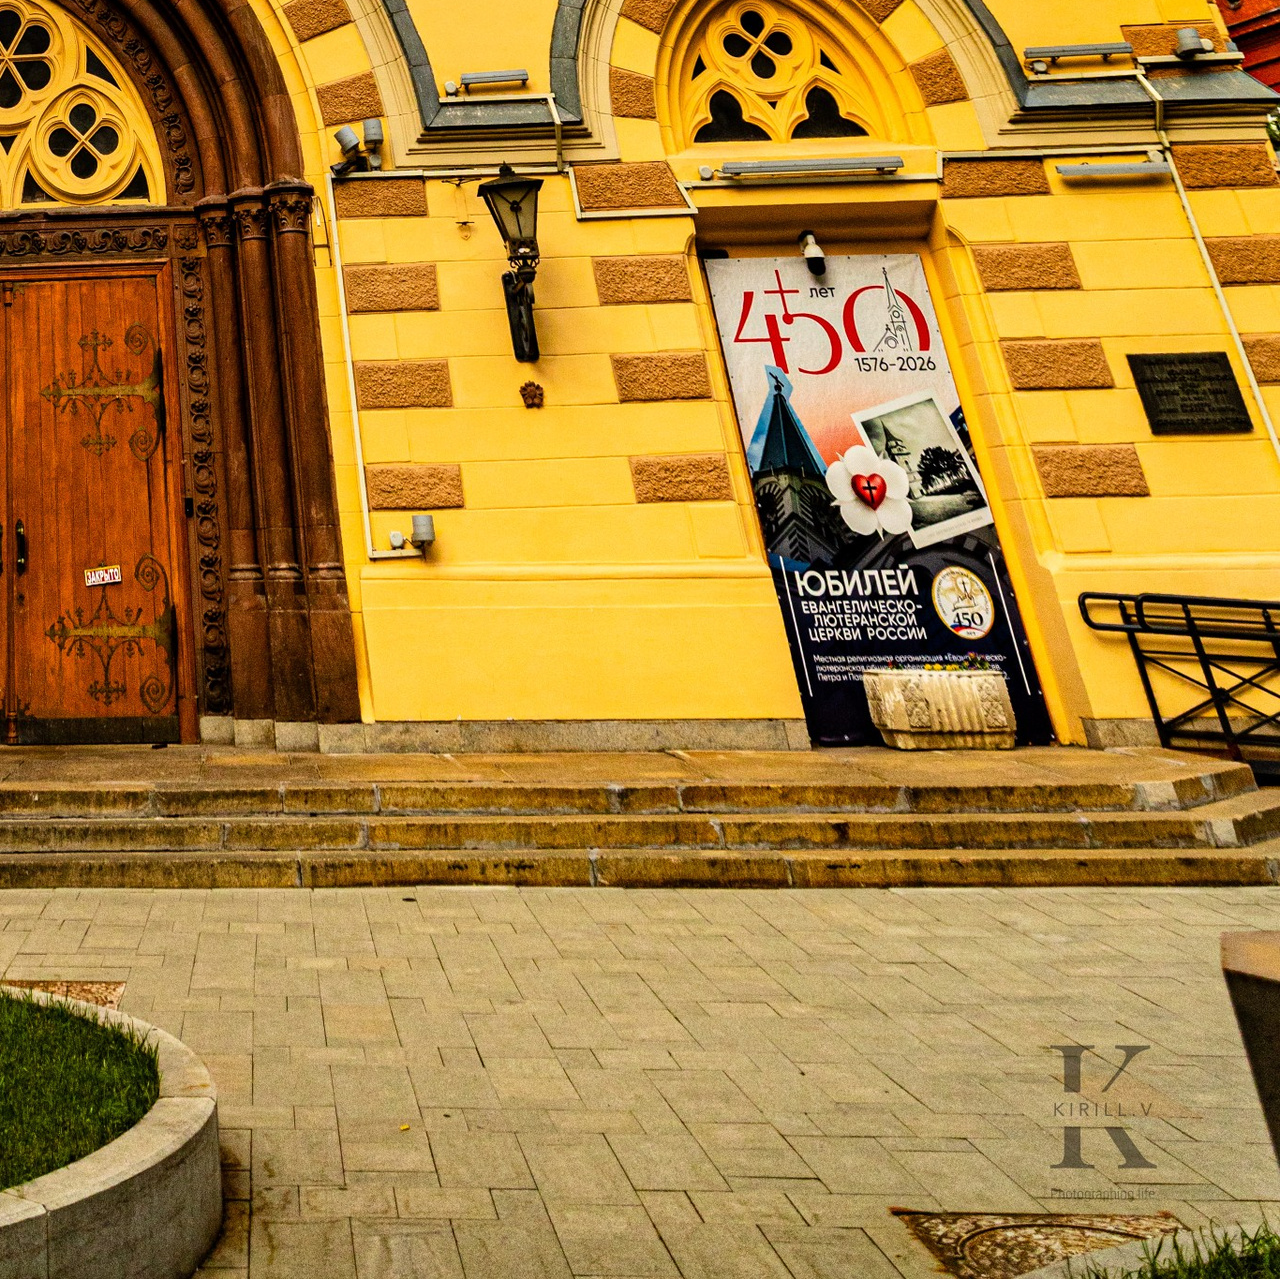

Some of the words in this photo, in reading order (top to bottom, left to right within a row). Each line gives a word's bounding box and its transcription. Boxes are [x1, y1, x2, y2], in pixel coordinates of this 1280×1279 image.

[809, 287, 836, 298] лет
[734, 269, 930, 375] 450
[854, 356, 936, 372] 1576-2026
[86, 568, 119, 585] ЗАКРЫТО
[794, 563, 919, 597] ЮБИЛЕЙ
[801, 599, 923, 614] ЕВАНГЕЛИЧЕСКО-
[814, 612, 918, 627] ЛЮТЕРАНСКОЙ
[953, 612, 984, 628] 450
[808, 627, 862, 642] ЦЕРКВИ
[867, 626, 928, 640] РОССИИ
[812, 653, 846, 663] Местная
[847, 654, 894, 664] религиозная
[894, 654, 943, 663] организация
[817, 672, 841, 682] Петра
